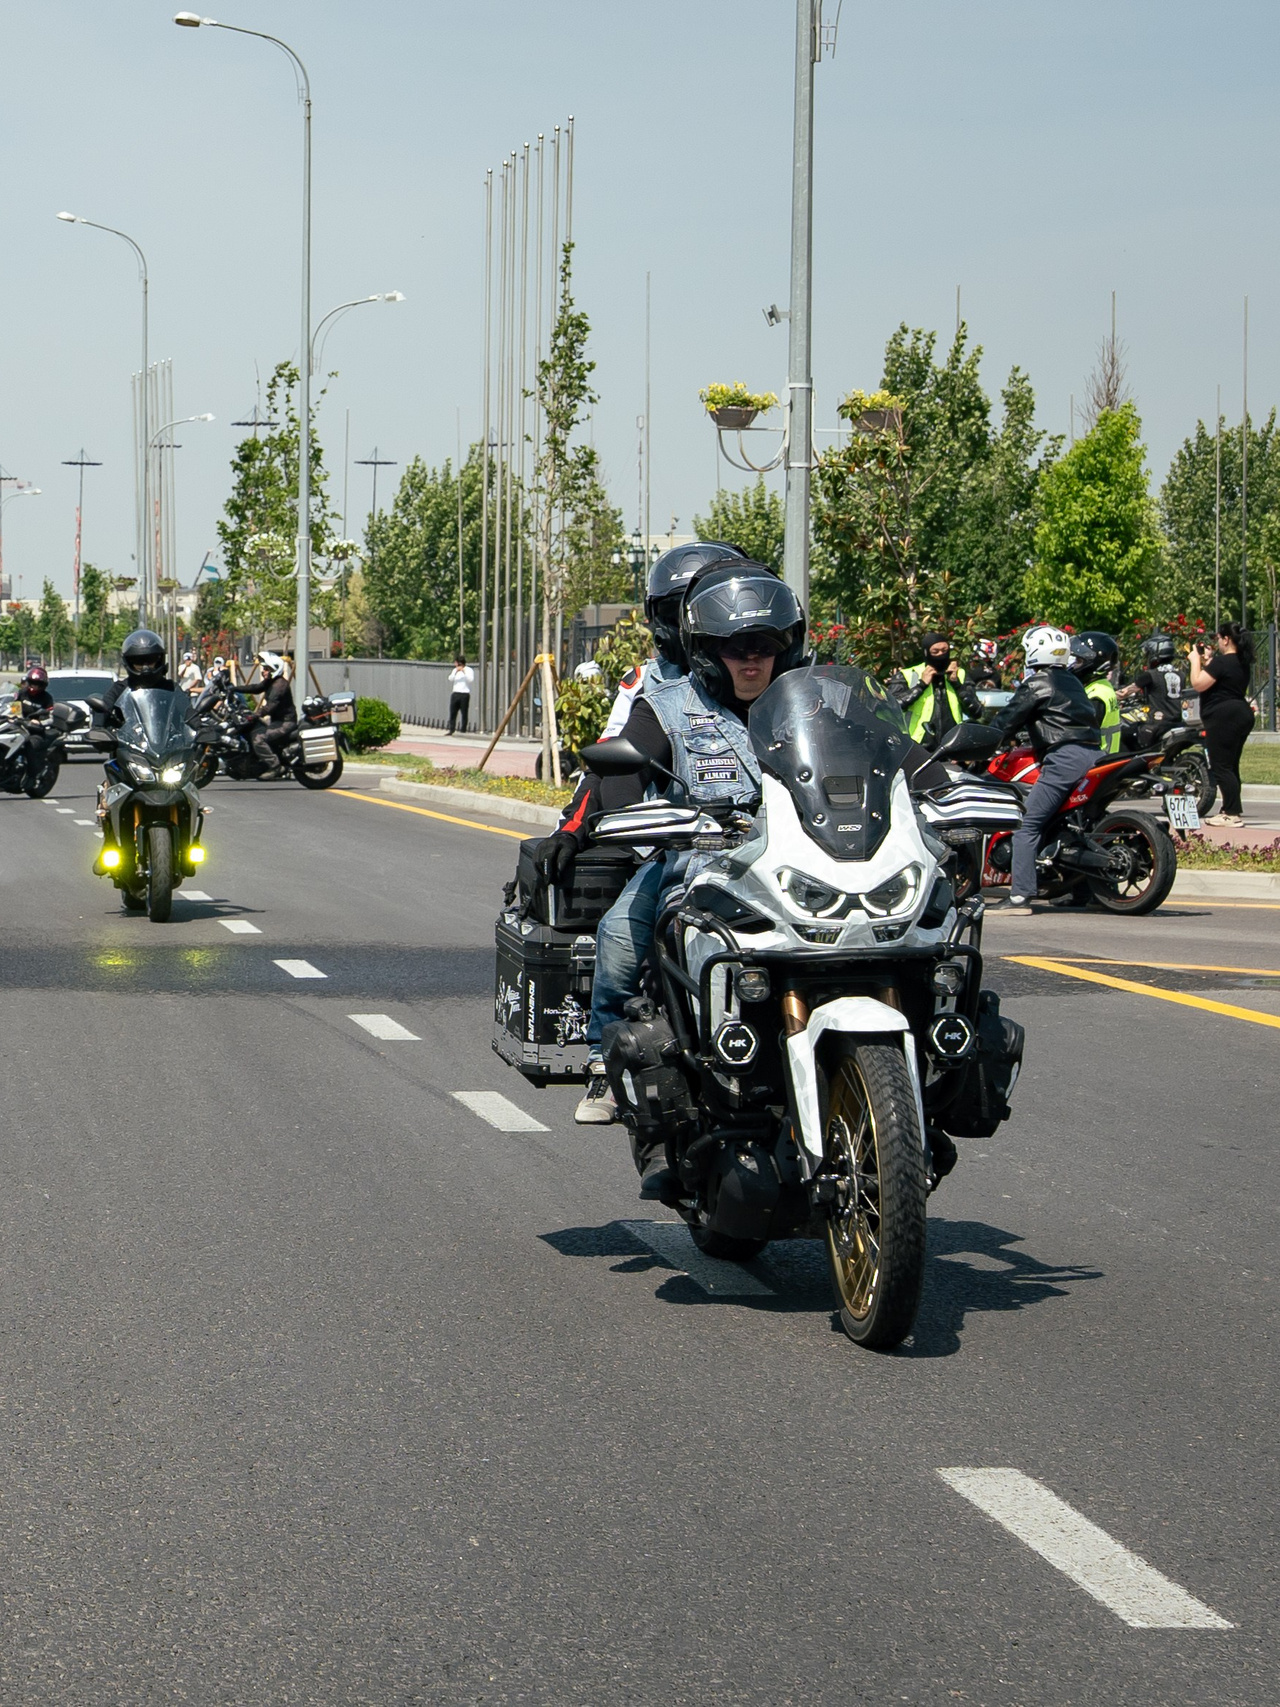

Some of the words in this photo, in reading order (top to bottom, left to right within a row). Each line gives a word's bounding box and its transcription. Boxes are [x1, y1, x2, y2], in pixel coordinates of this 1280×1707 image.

[669, 571, 698, 581] LS
[728, 609, 772, 621] LS2
[696, 758, 736, 768] KAZAKHSTAN
[703, 771, 732, 781] ALMATY
[1170, 797, 1186, 811] 677
[1173, 812, 1190, 828] HA
[944, 1032, 962, 1040] HK
[729, 1039, 747, 1048] HK
